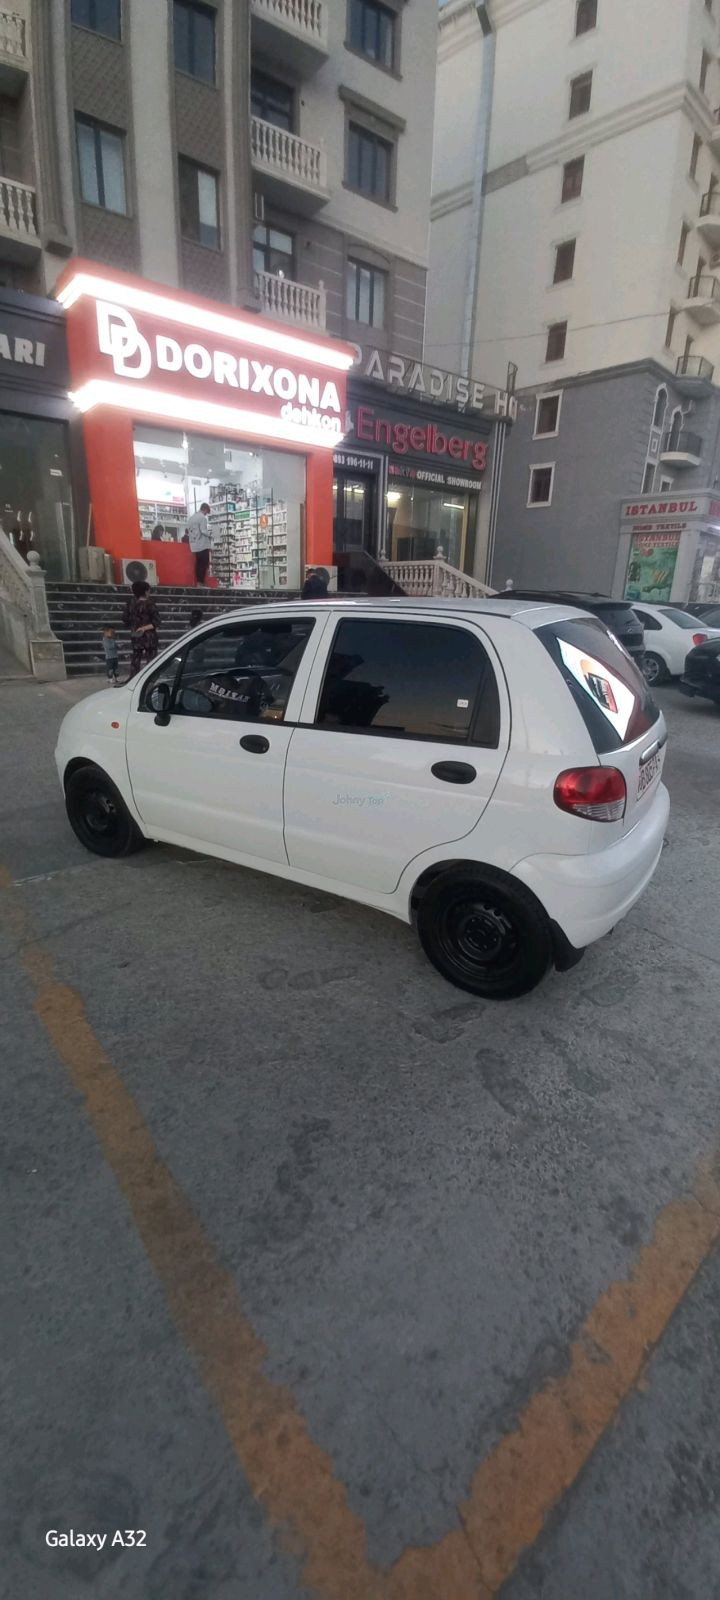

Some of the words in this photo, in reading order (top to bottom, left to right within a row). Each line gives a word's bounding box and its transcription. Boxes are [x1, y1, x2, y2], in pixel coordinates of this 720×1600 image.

[155, 334, 341, 412] DORIXONA
[356, 407, 488, 470] Engelberg
[416, 470, 445, 484] OFFICIAL
[447, 476, 483, 490] SHOWROOM
[625, 501, 698, 516] ISTANBUL
